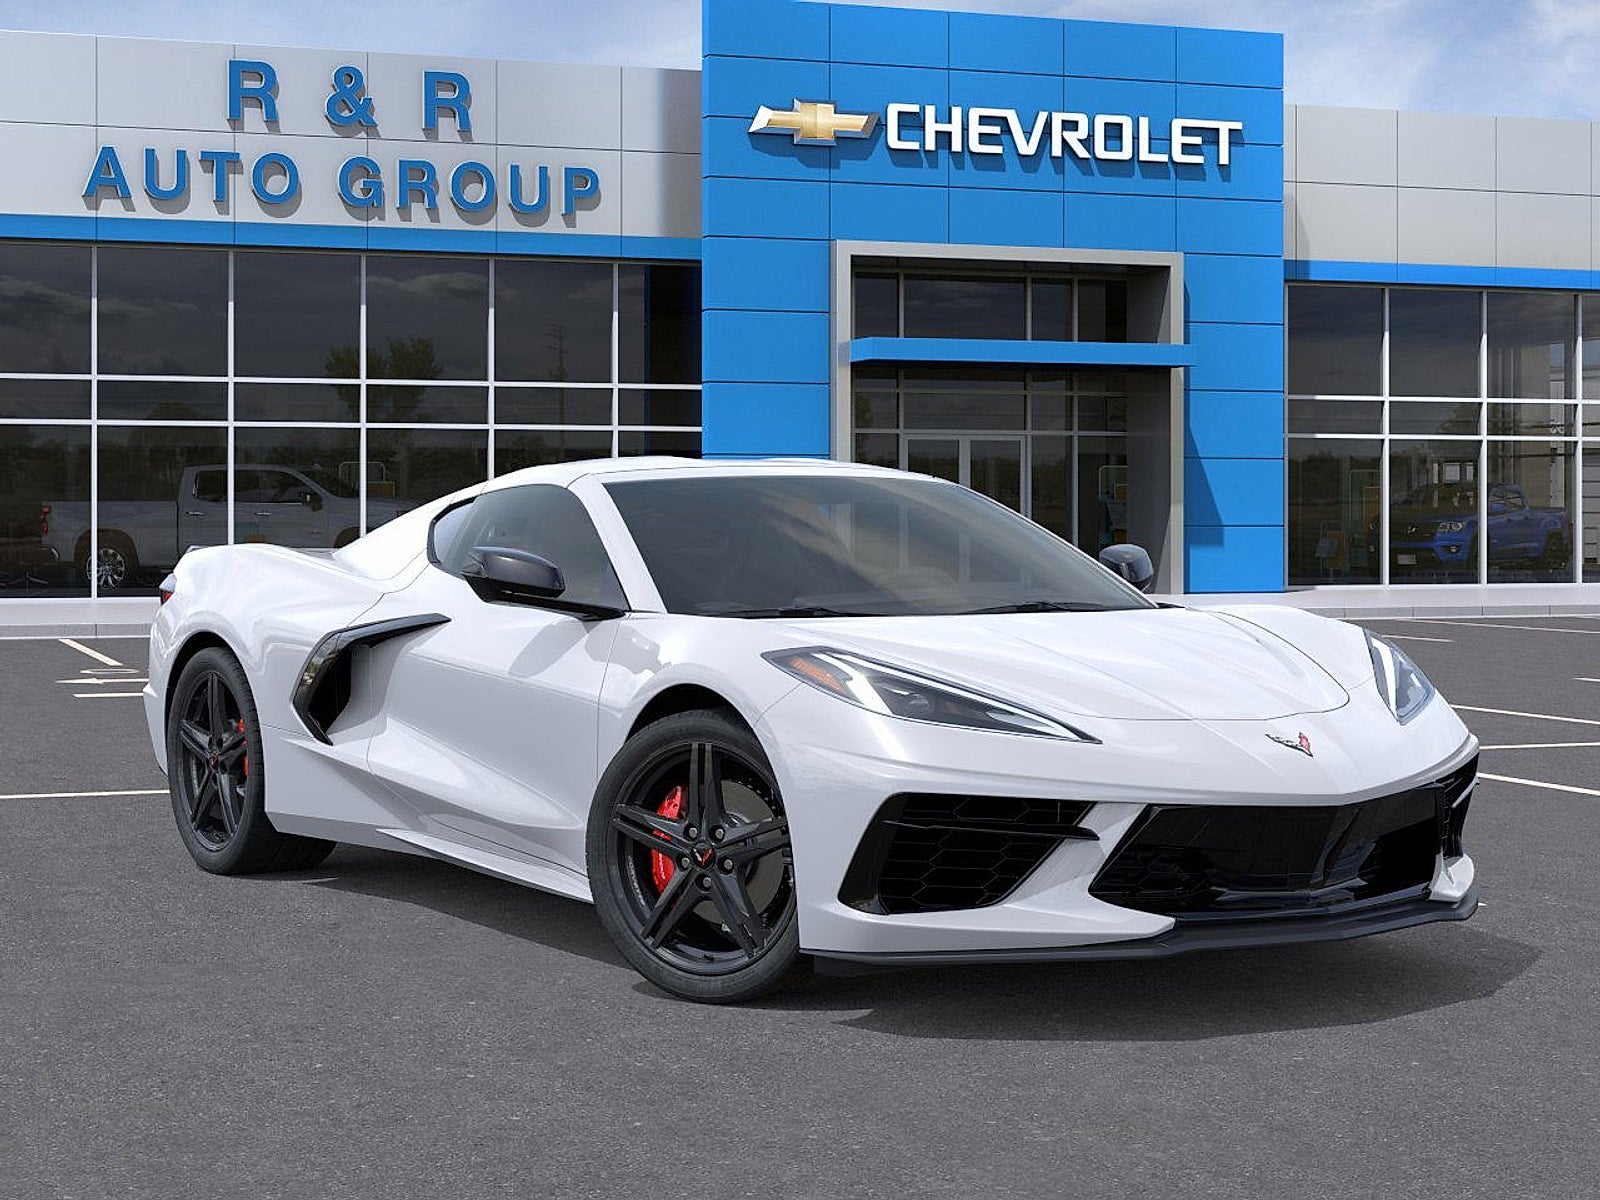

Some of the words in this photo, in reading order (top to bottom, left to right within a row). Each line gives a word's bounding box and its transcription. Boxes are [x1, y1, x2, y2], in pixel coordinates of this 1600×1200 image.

[227, 59, 278, 121] R
[325, 64, 377, 126] &
[422, 69, 471, 131] R
[886, 103, 1243, 165] CHEVROLET
[83, 145, 299, 204] AUTO
[338, 155, 600, 215] GROUP
